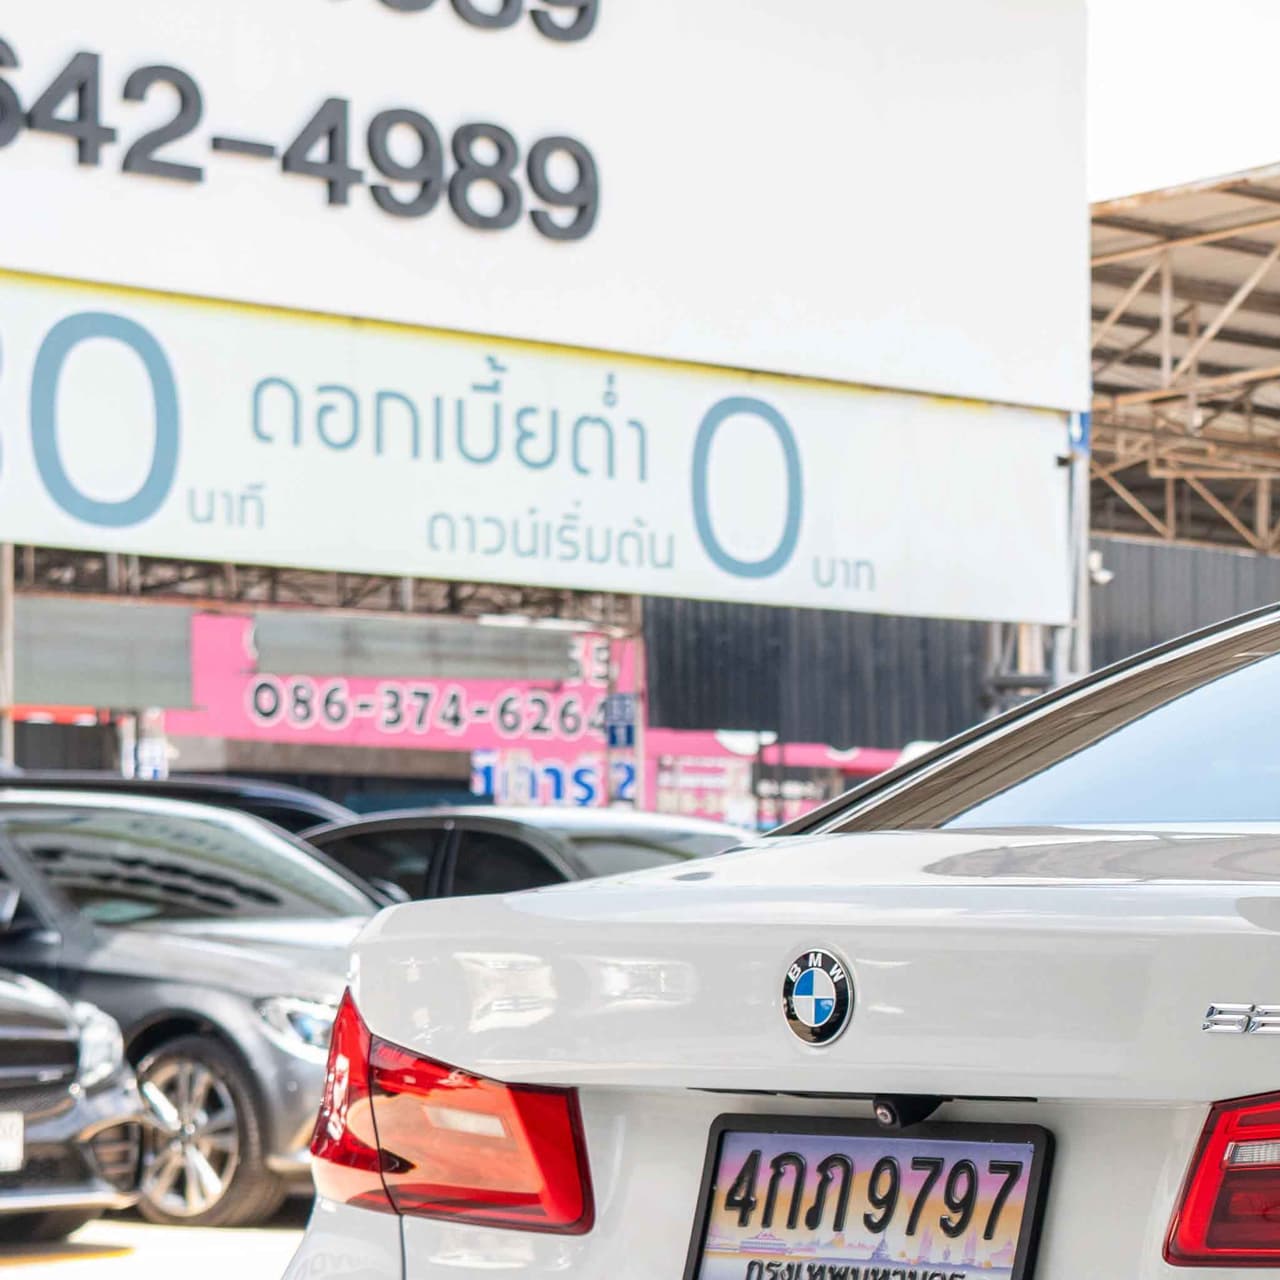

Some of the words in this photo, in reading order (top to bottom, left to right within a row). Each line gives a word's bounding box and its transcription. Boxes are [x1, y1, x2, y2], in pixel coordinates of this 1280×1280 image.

[251, 354, 648, 482] ดอกเบี้ยต่ำ
[691, 395, 803, 579] 0
[812, 553, 877, 592] บาท
[788, 953, 844, 982] BMW
[863, 1155, 1023, 1241] 9797
